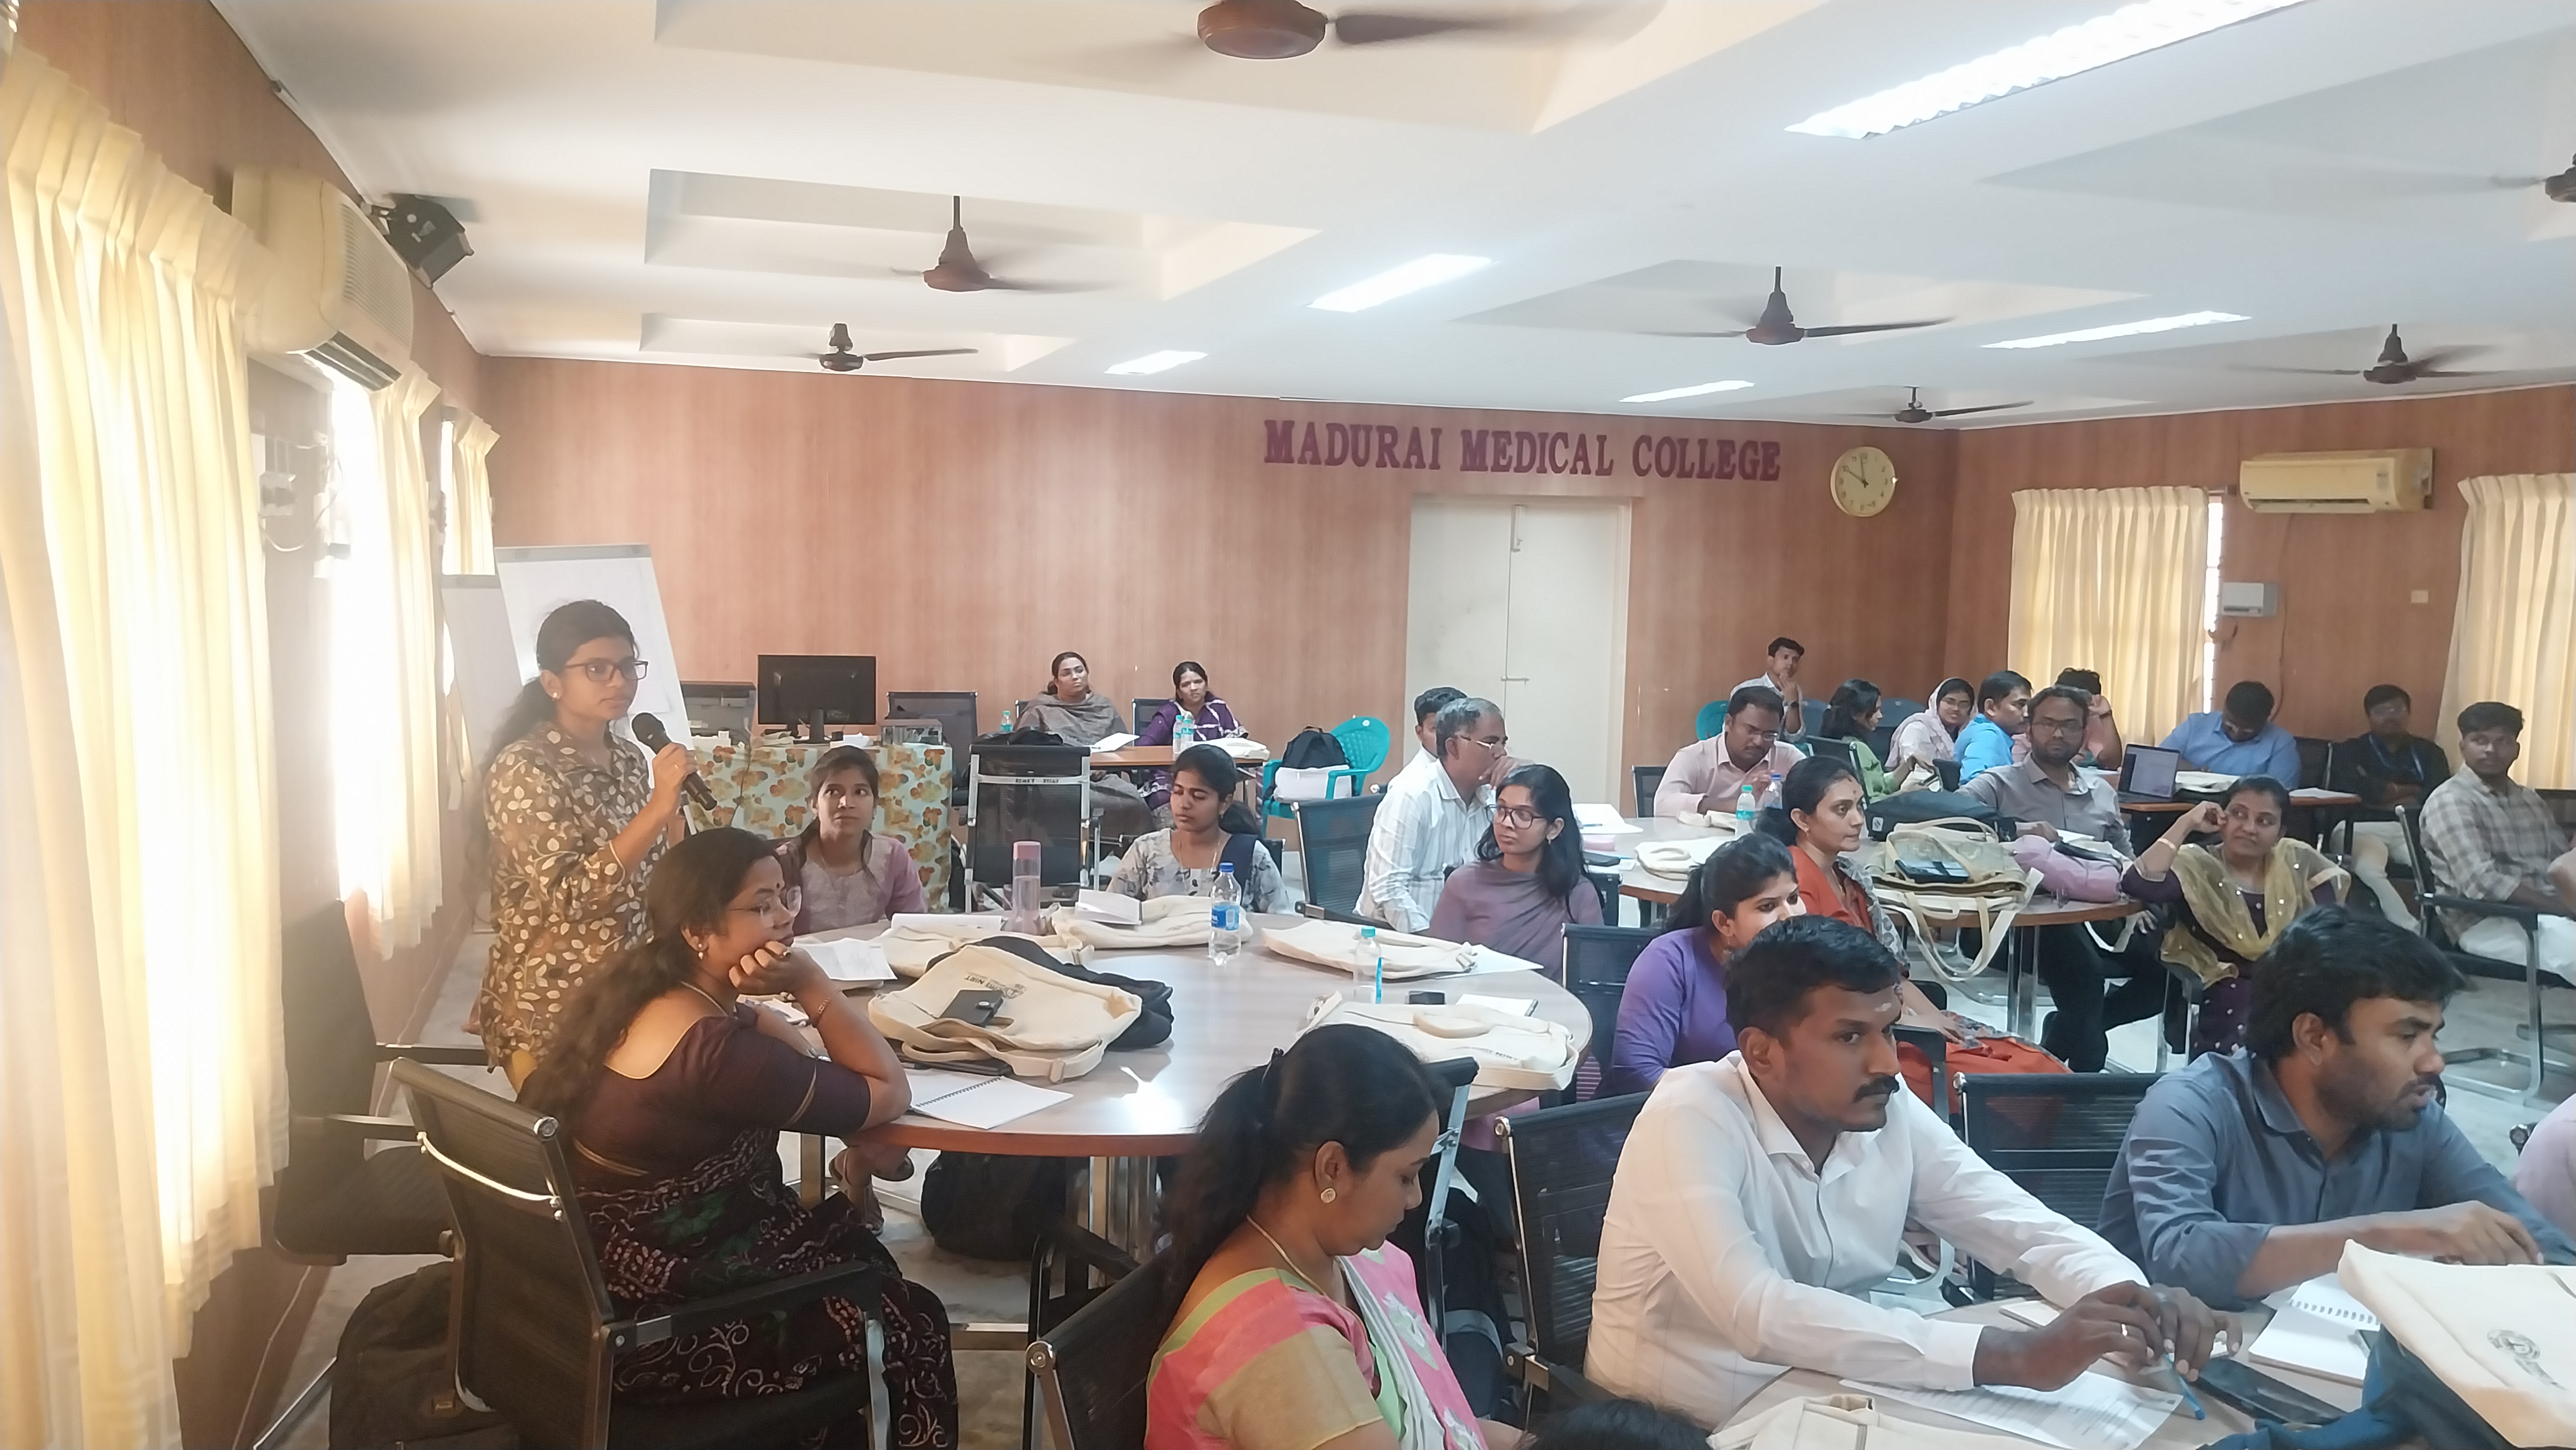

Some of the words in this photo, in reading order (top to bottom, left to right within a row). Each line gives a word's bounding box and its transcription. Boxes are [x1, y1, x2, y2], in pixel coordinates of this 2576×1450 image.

[1264, 419, 1441, 470] MADURAI
[1460, 429, 1614, 477] MEDICAL
[1633, 434, 1780, 482] COLLEGE
[964, 975, 985, 985] NIRT
